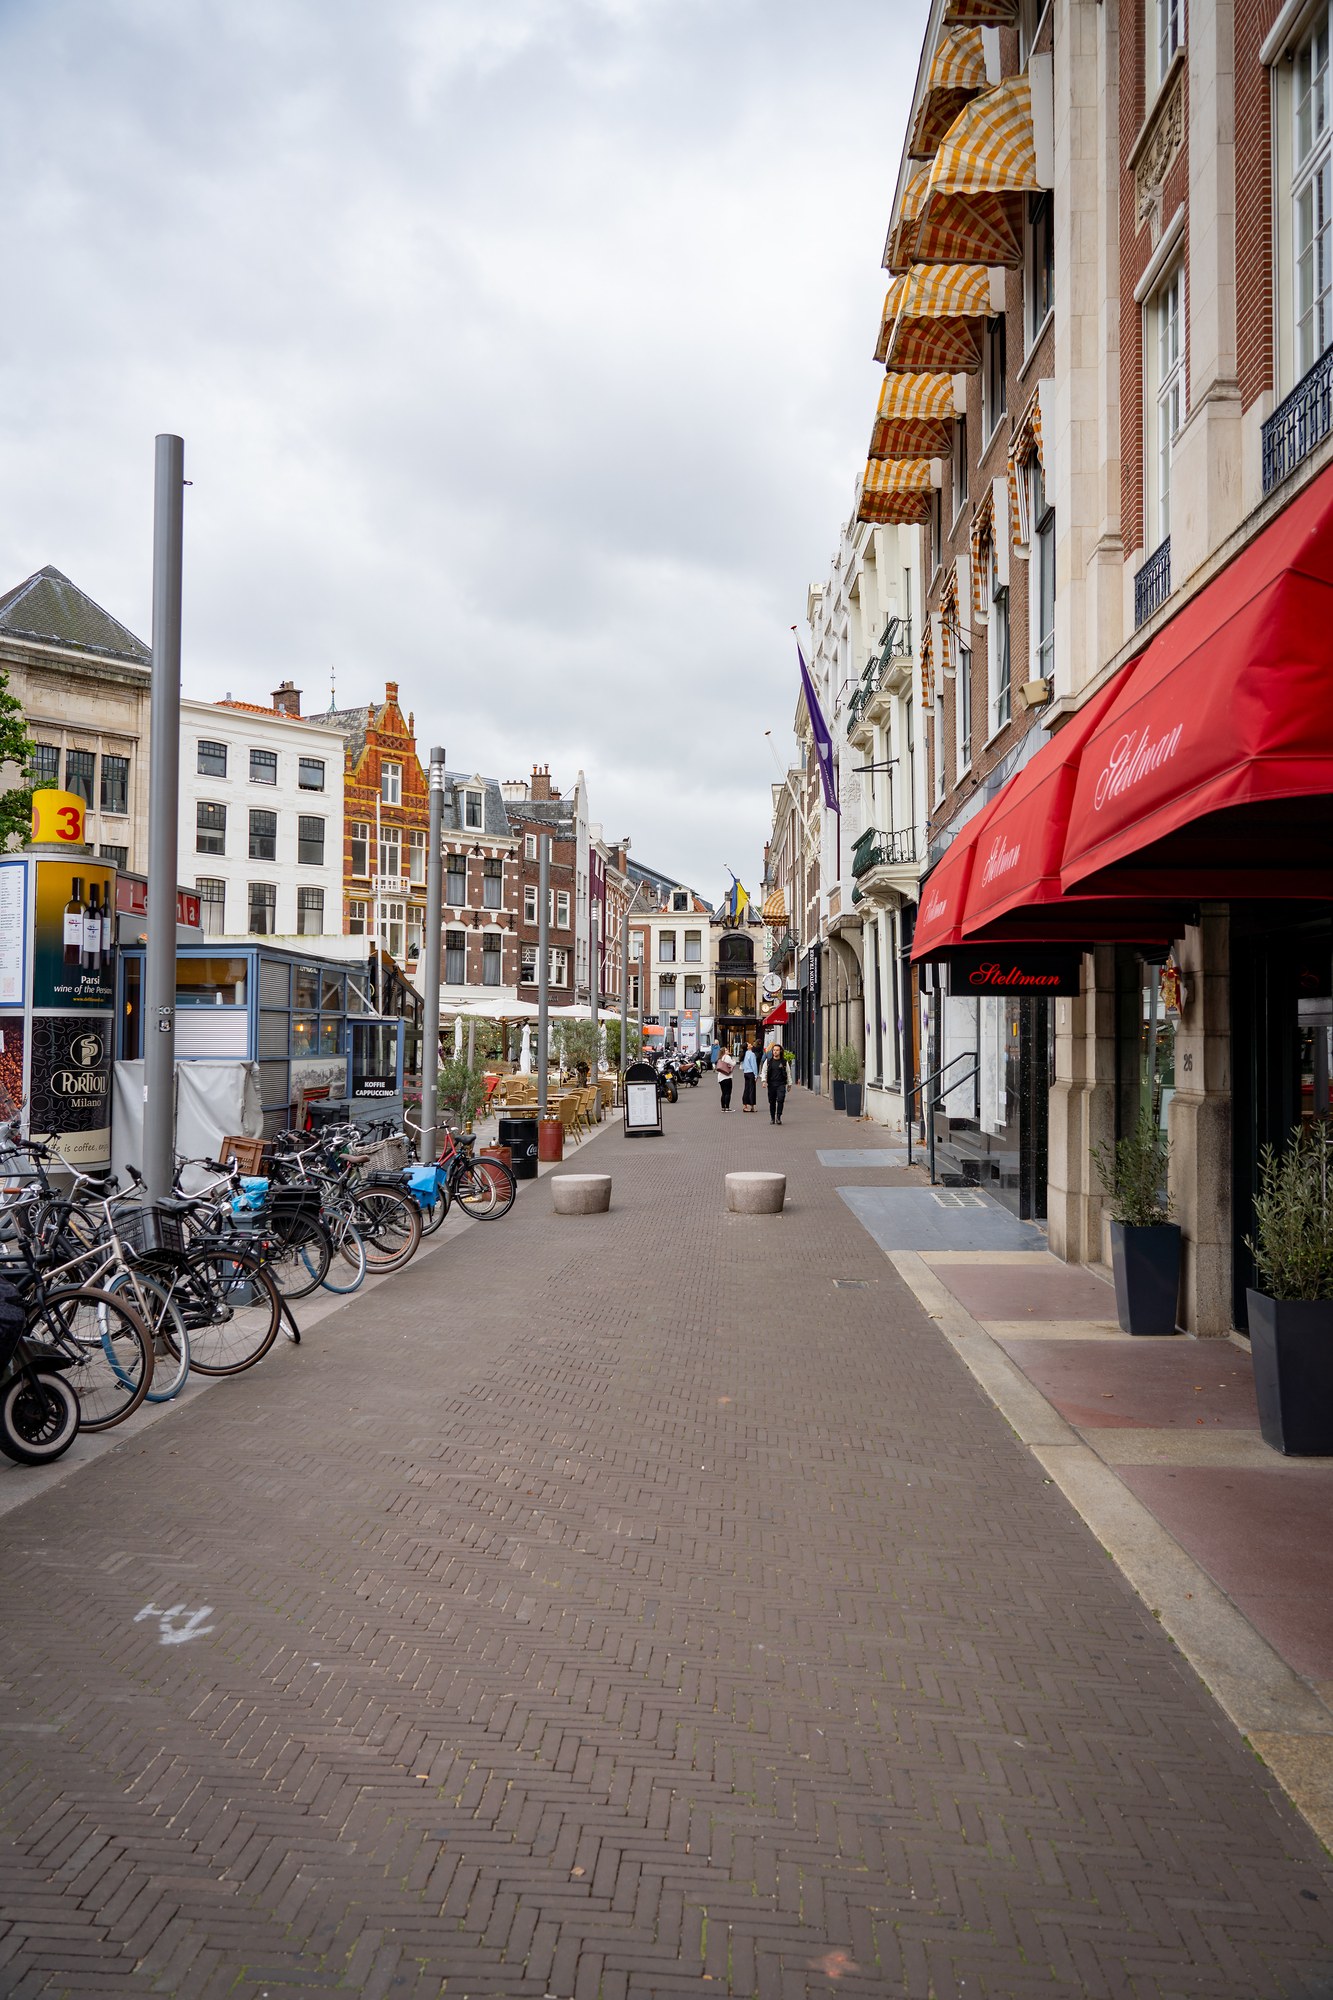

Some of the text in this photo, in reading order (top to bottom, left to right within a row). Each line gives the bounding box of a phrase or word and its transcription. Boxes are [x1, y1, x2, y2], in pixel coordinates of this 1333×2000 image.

[1094, 723, 1183, 811] Steltman
[56, 806, 81, 841] 3
[981, 835, 1021, 888] Steltman
[81, 975, 100, 985] Parsi
[969, 962, 1061, 986] Steltman
[54, 985, 73, 993] wine
[74, 985, 83, 995] of
[84, 985, 95, 994] the
[1183, 1053, 1193, 1072] 26
[62, 1072, 106, 1094] PORTIOLI
[355, 1089, 394, 1097] CAPPUCCINO
[71, 1098, 102, 1108] Milano
[64, 1144, 71, 1153] is
